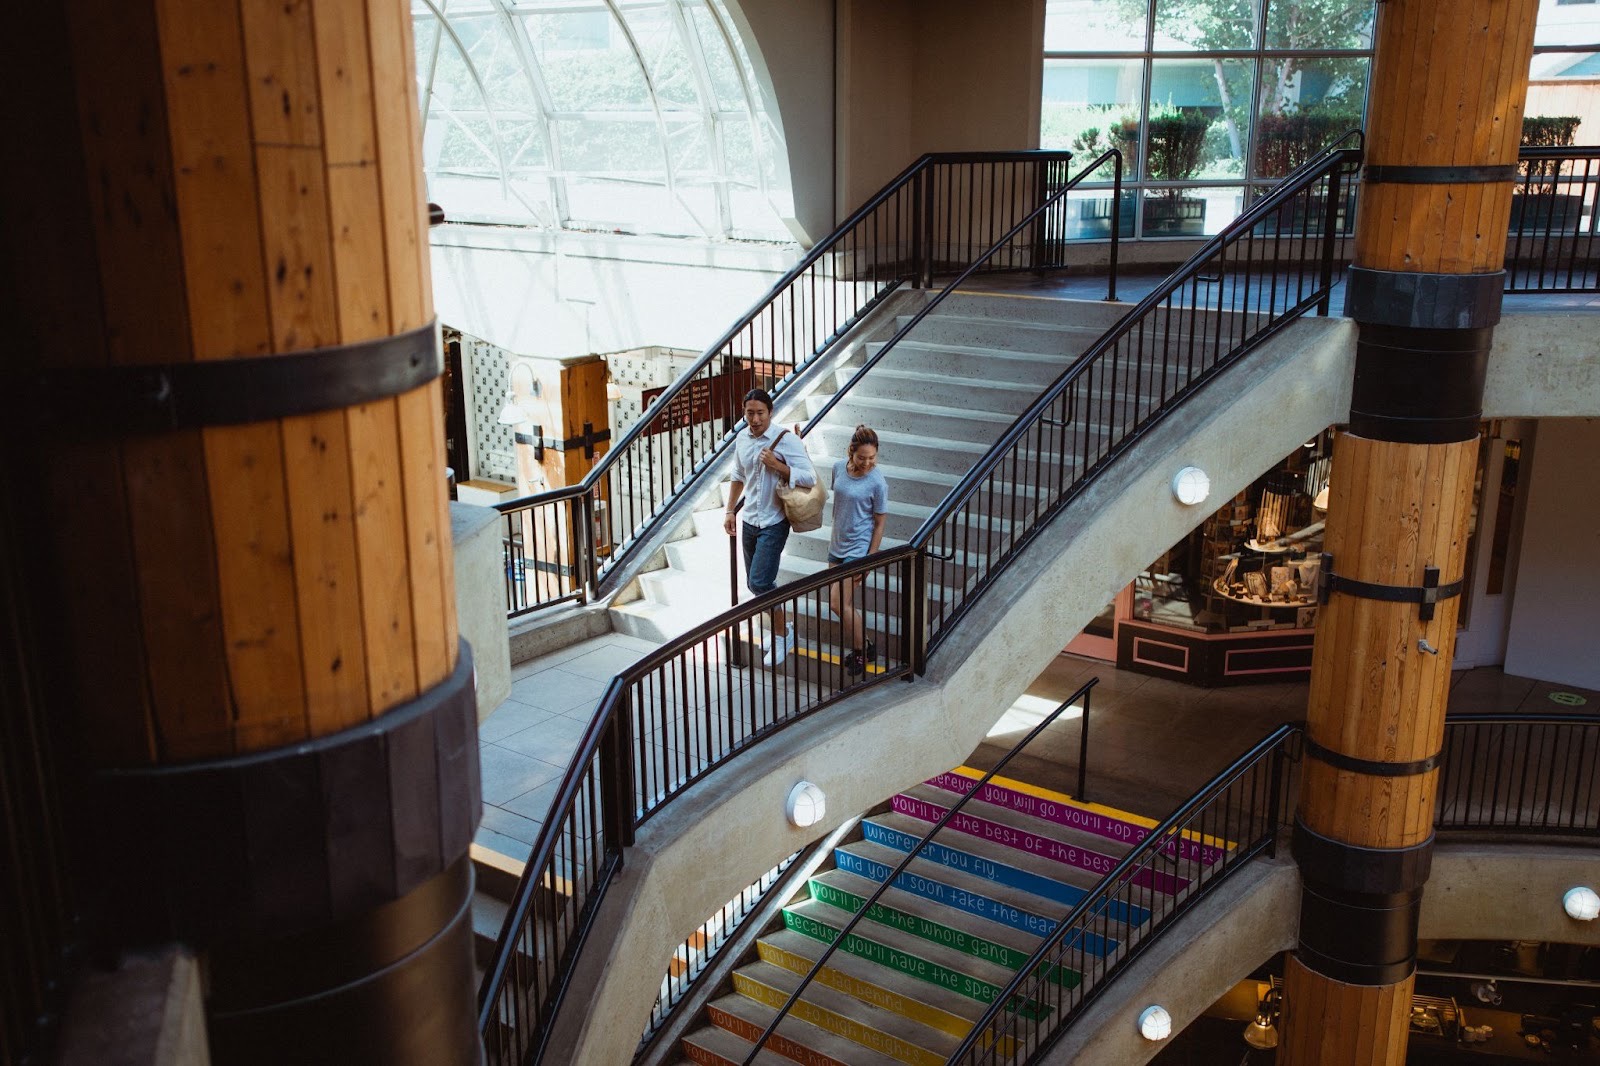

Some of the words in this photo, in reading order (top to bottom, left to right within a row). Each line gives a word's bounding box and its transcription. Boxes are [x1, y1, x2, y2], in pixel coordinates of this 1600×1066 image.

[985, 786, 1008, 803] you
[1013, 794, 1035, 811] will
[1040, 803, 1060, 818] go.
[1106, 821, 1131, 840] top
[941, 848, 968, 867] you
[974, 859, 999, 879] fly.
[954, 815, 980, 833] the
[985, 823, 1019, 844] best
[1024, 836, 1043, 851] of
[1050, 843, 1077, 862] the
[1083, 852, 1117, 872] bes
[839, 854, 863, 872] And
[910, 876, 944, 898] soon
[950, 890, 985, 911] take
[991, 904, 1019, 923] the
[852, 897, 884, 919] pss
[890, 912, 915, 930] the
[920, 922, 965, 947] whole
[971, 939, 1013, 966] gang.
[890, 953, 926, 975] have
[931, 967, 958, 987] the
[805, 1007, 820, 1021] to
[780, 1040, 803, 1059] the
